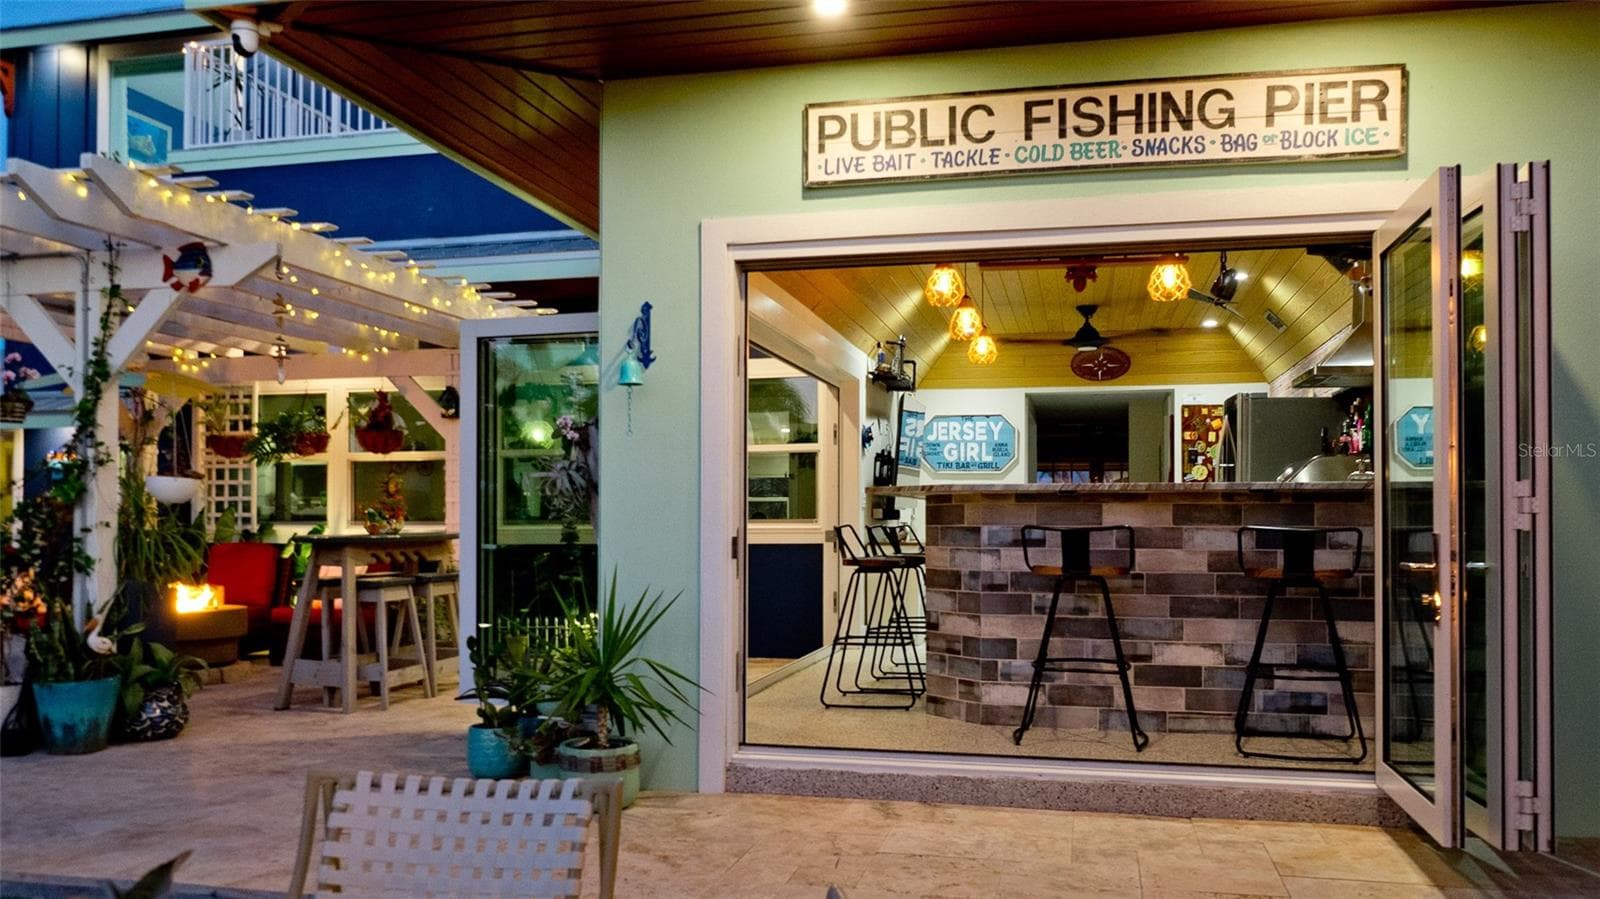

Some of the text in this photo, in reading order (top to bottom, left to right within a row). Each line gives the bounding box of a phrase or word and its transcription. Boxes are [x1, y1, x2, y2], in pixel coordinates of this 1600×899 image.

[818, 79, 1390, 154] PUBLIC FISHING PIER
[824, 156, 866, 176] LIVE
[873, 153, 916, 173] BAIT
[931, 148, 1001, 169] TACKLE
[1014, 143, 1064, 164] COLD
[1070, 139, 1122, 160] BEER
[1132, 135, 1206, 157] SNACKS
[1220, 133, 1258, 153] BAG
[1280, 129, 1338, 149] BLOCK
[1344, 127, 1380, 147] ICE
[926, 421, 1004, 441] JERSEY
[943, 442, 993, 462] GIRL
[936, 462, 953, 470] TIKI
[955, 462, 971, 470] BAR
[977, 462, 1000, 470] GRILL
